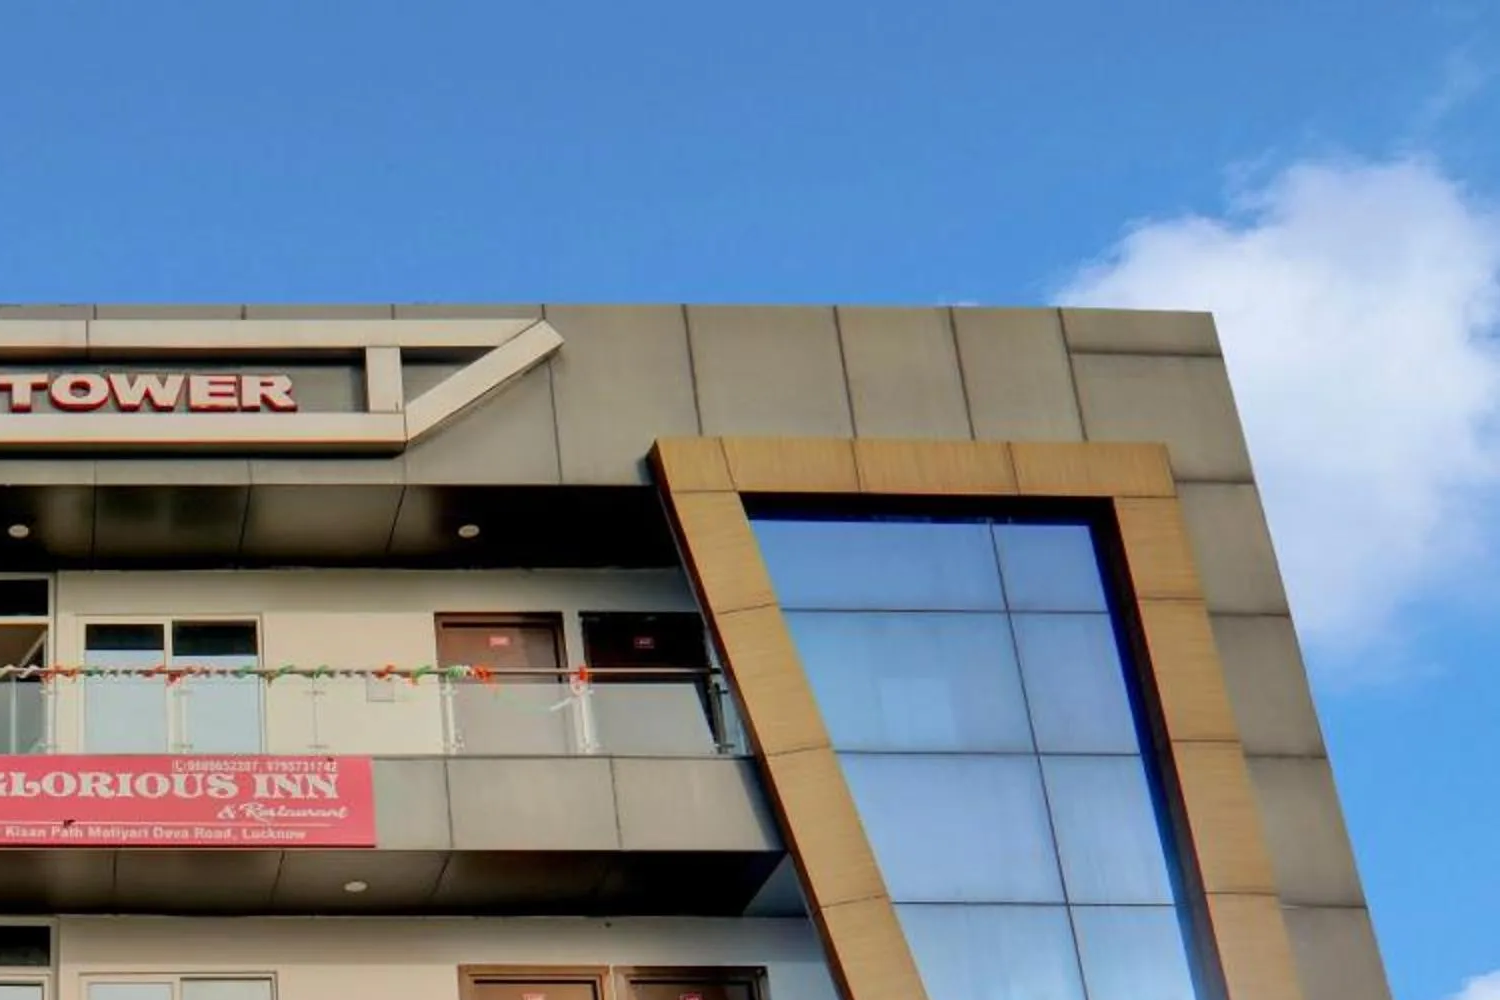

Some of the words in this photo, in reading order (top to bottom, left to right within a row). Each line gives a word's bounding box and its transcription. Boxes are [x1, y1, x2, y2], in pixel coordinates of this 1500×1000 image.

[253, 773, 339, 799] INN
[52, 826, 83, 838] Path
[243, 828, 306, 840] Lucknow
